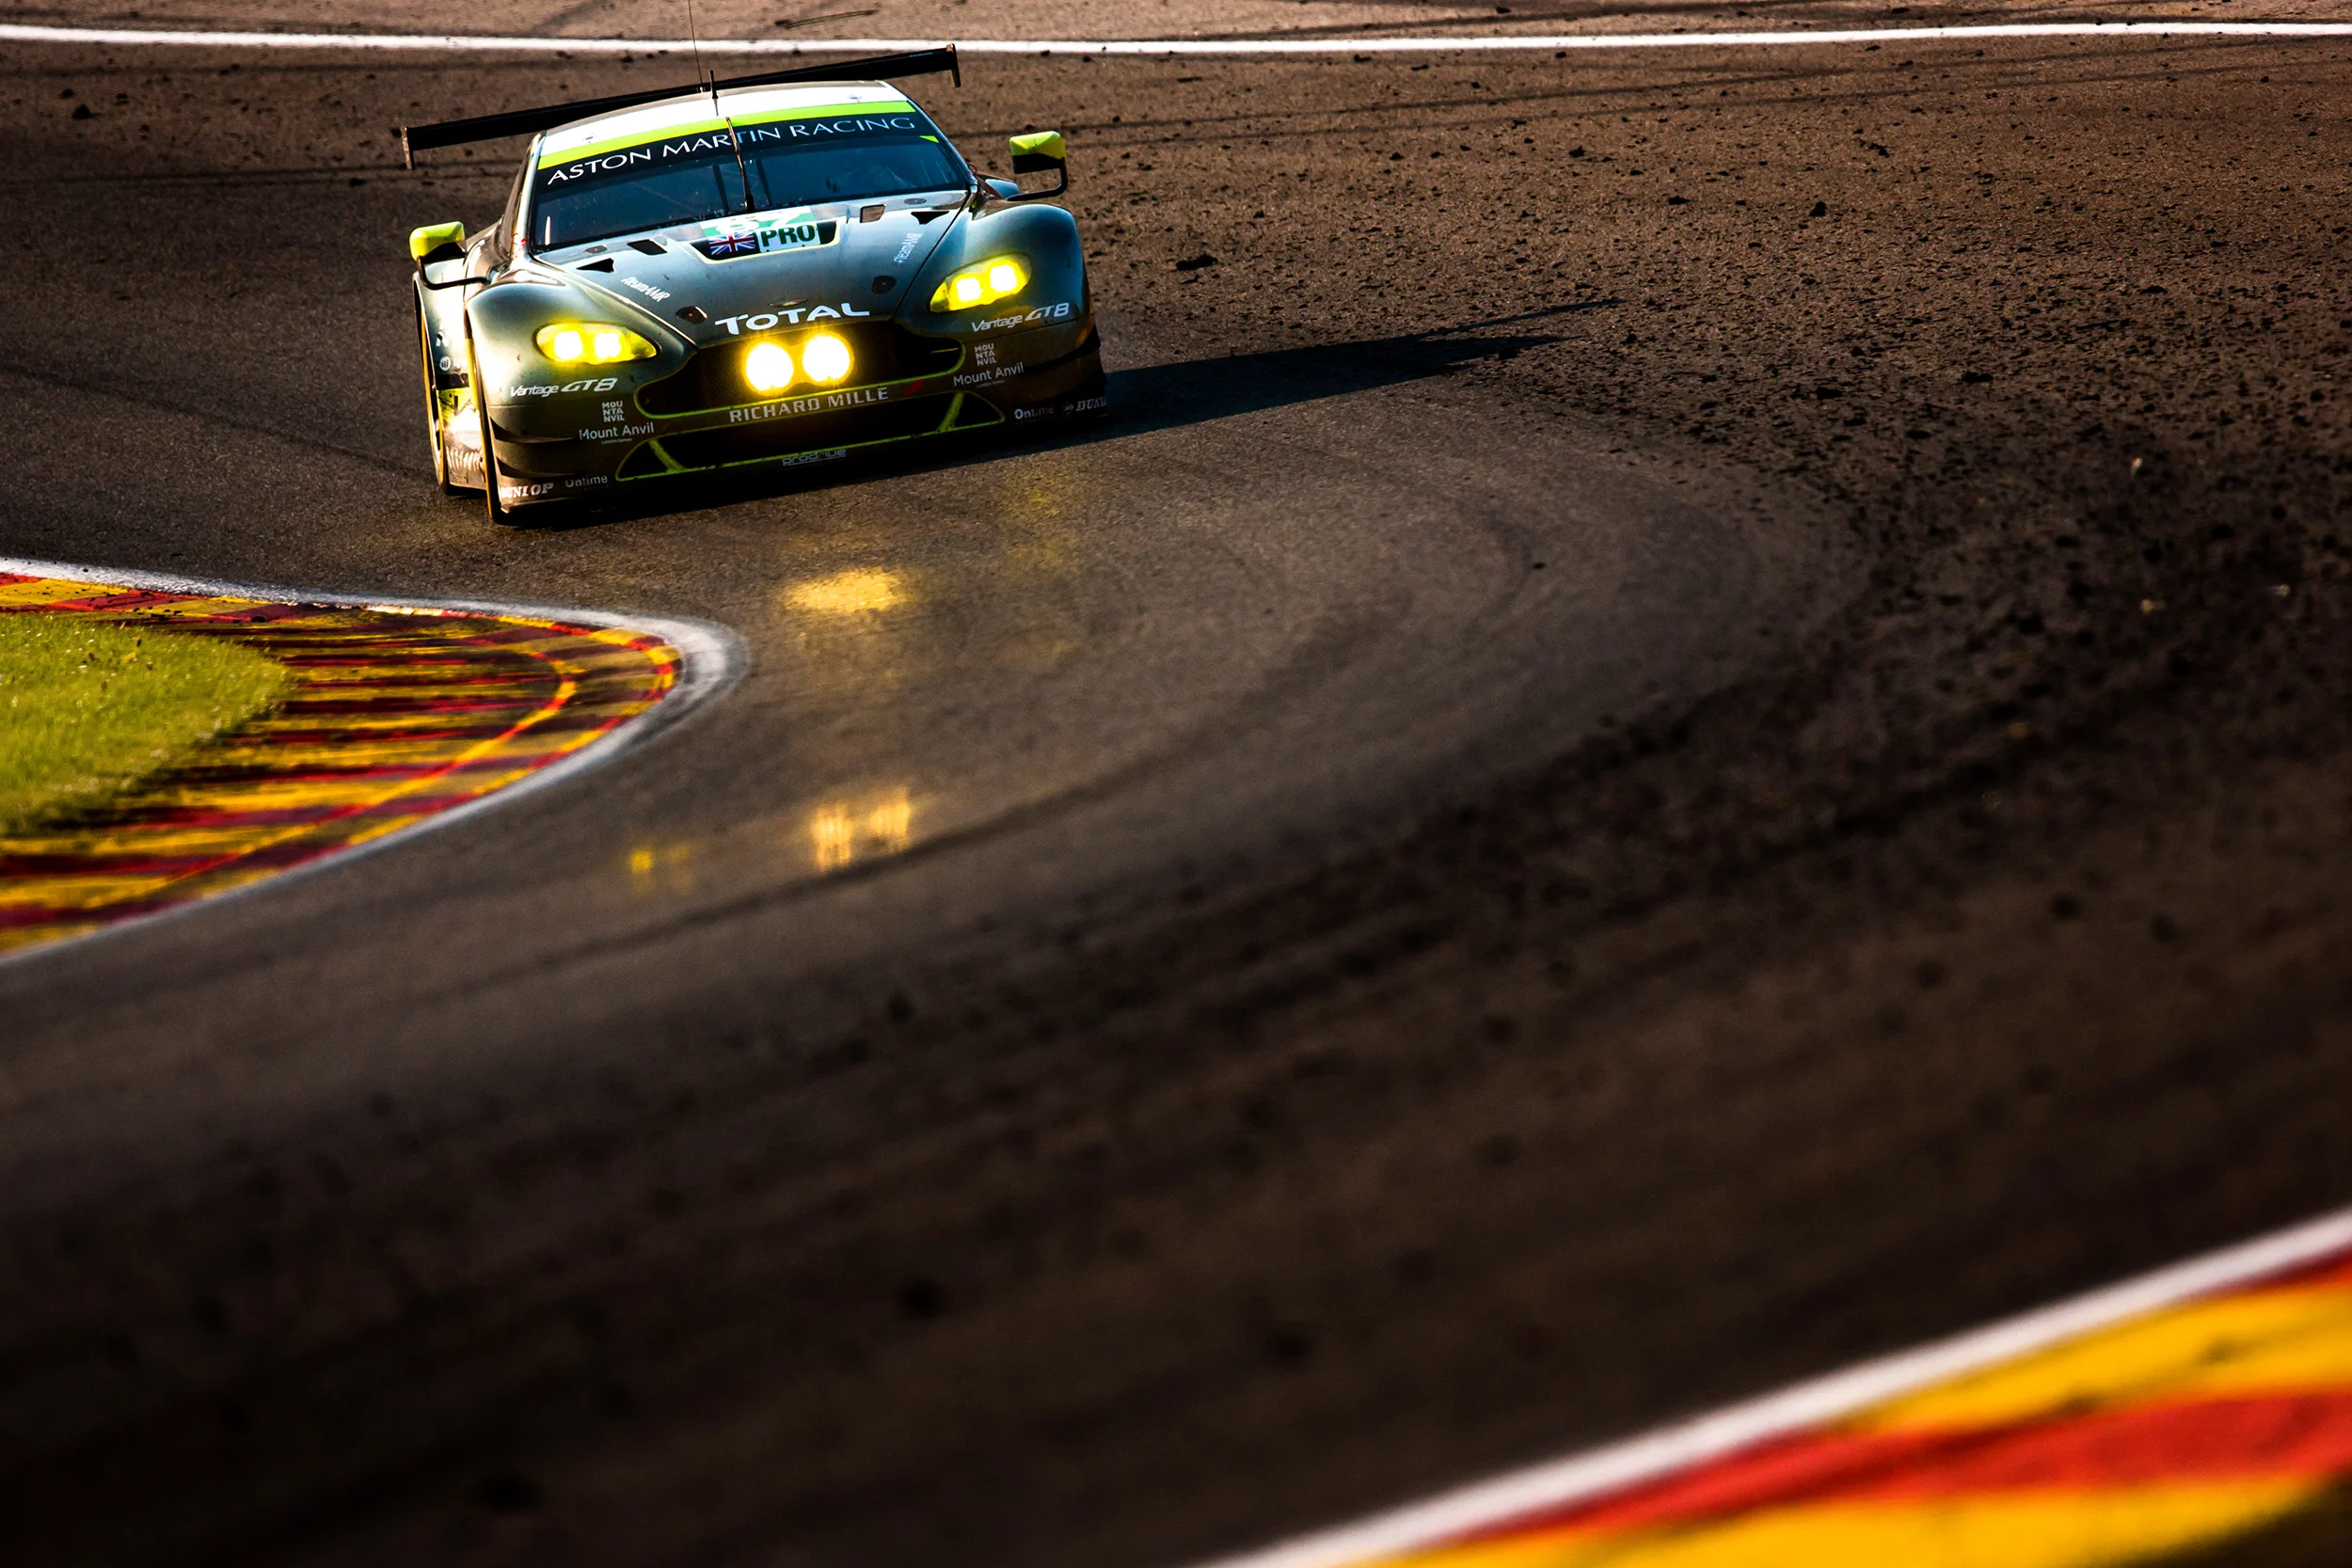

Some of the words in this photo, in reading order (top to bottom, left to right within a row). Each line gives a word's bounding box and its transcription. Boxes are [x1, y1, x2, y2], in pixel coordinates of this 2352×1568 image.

[548, 149, 651, 185] ASTON
[662, 129, 781, 158] MARTIN
[789, 117, 915, 137] RACING
[760, 224, 816, 247] PRO
[714, 302, 870, 336] TOTAL
[971, 314, 1023, 332] Vantage
[1025, 302, 1070, 322] GT8
[974, 342, 994, 353] MOU
[976, 349, 996, 359] NTA
[977, 356, 997, 367] NVIL
[953, 370, 993, 387] Mount
[995, 361, 1025, 377] Anvil
[510, 385, 559, 398] Vantage
[561, 377, 618, 392] GT8
[601, 400, 624, 409] MOU
[602, 407, 625, 417] NTA
[729, 397, 820, 423] RICHARD
[827, 387, 889, 408] MILLE
[603, 414, 626, 423] NVIL
[579, 427, 618, 440] Mount
[622, 421, 655, 436] Anvil
